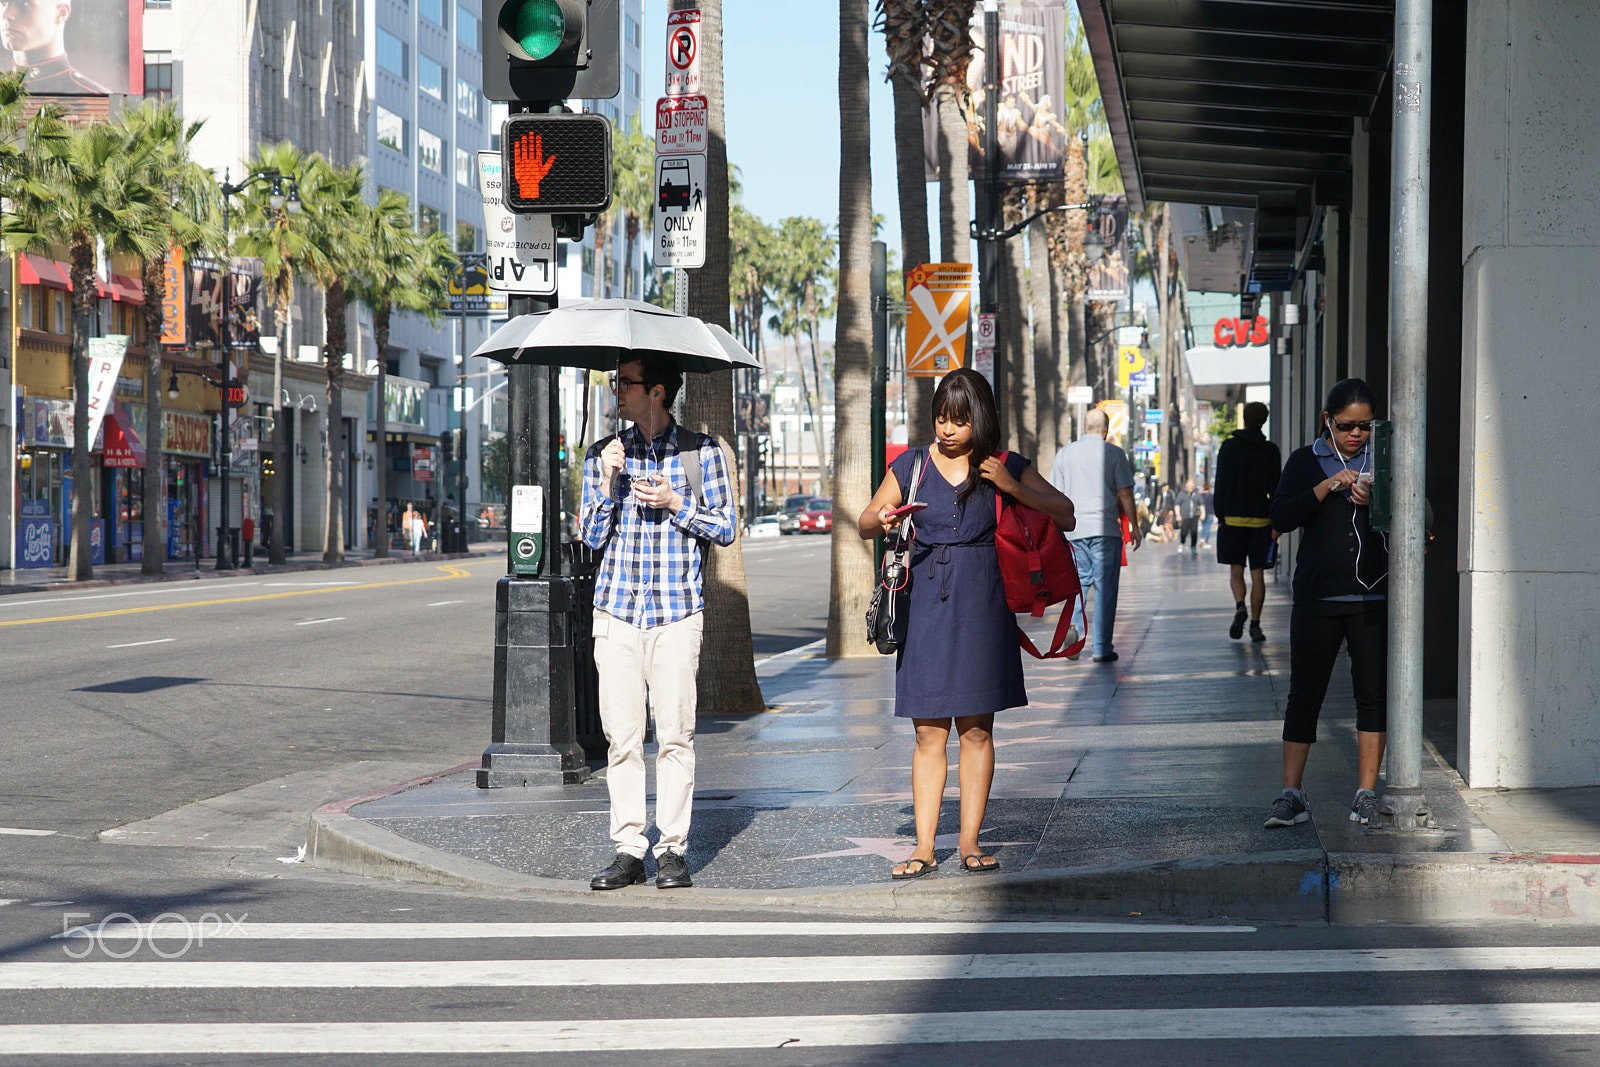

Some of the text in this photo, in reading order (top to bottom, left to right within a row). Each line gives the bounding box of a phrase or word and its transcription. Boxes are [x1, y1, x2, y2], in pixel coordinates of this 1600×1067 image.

[685, 72, 697, 85] 6AM
[1002, 71, 1043, 96] STREET
[658, 111, 704, 128] NO STOPPING
[661, 129, 677, 144] 6AM
[685, 128, 702, 143] 11PM
[481, 162, 502, 175] afety
[664, 216, 694, 232] ONLY
[506, 241, 540, 250] PROTECT
[661, 235, 675, 248] 6AM
[682, 235, 697, 247] 11PM
[466, 295, 483, 303] WILD
[1214, 315, 1268, 346] CVS
[166, 413, 209, 454] LIQUOR
